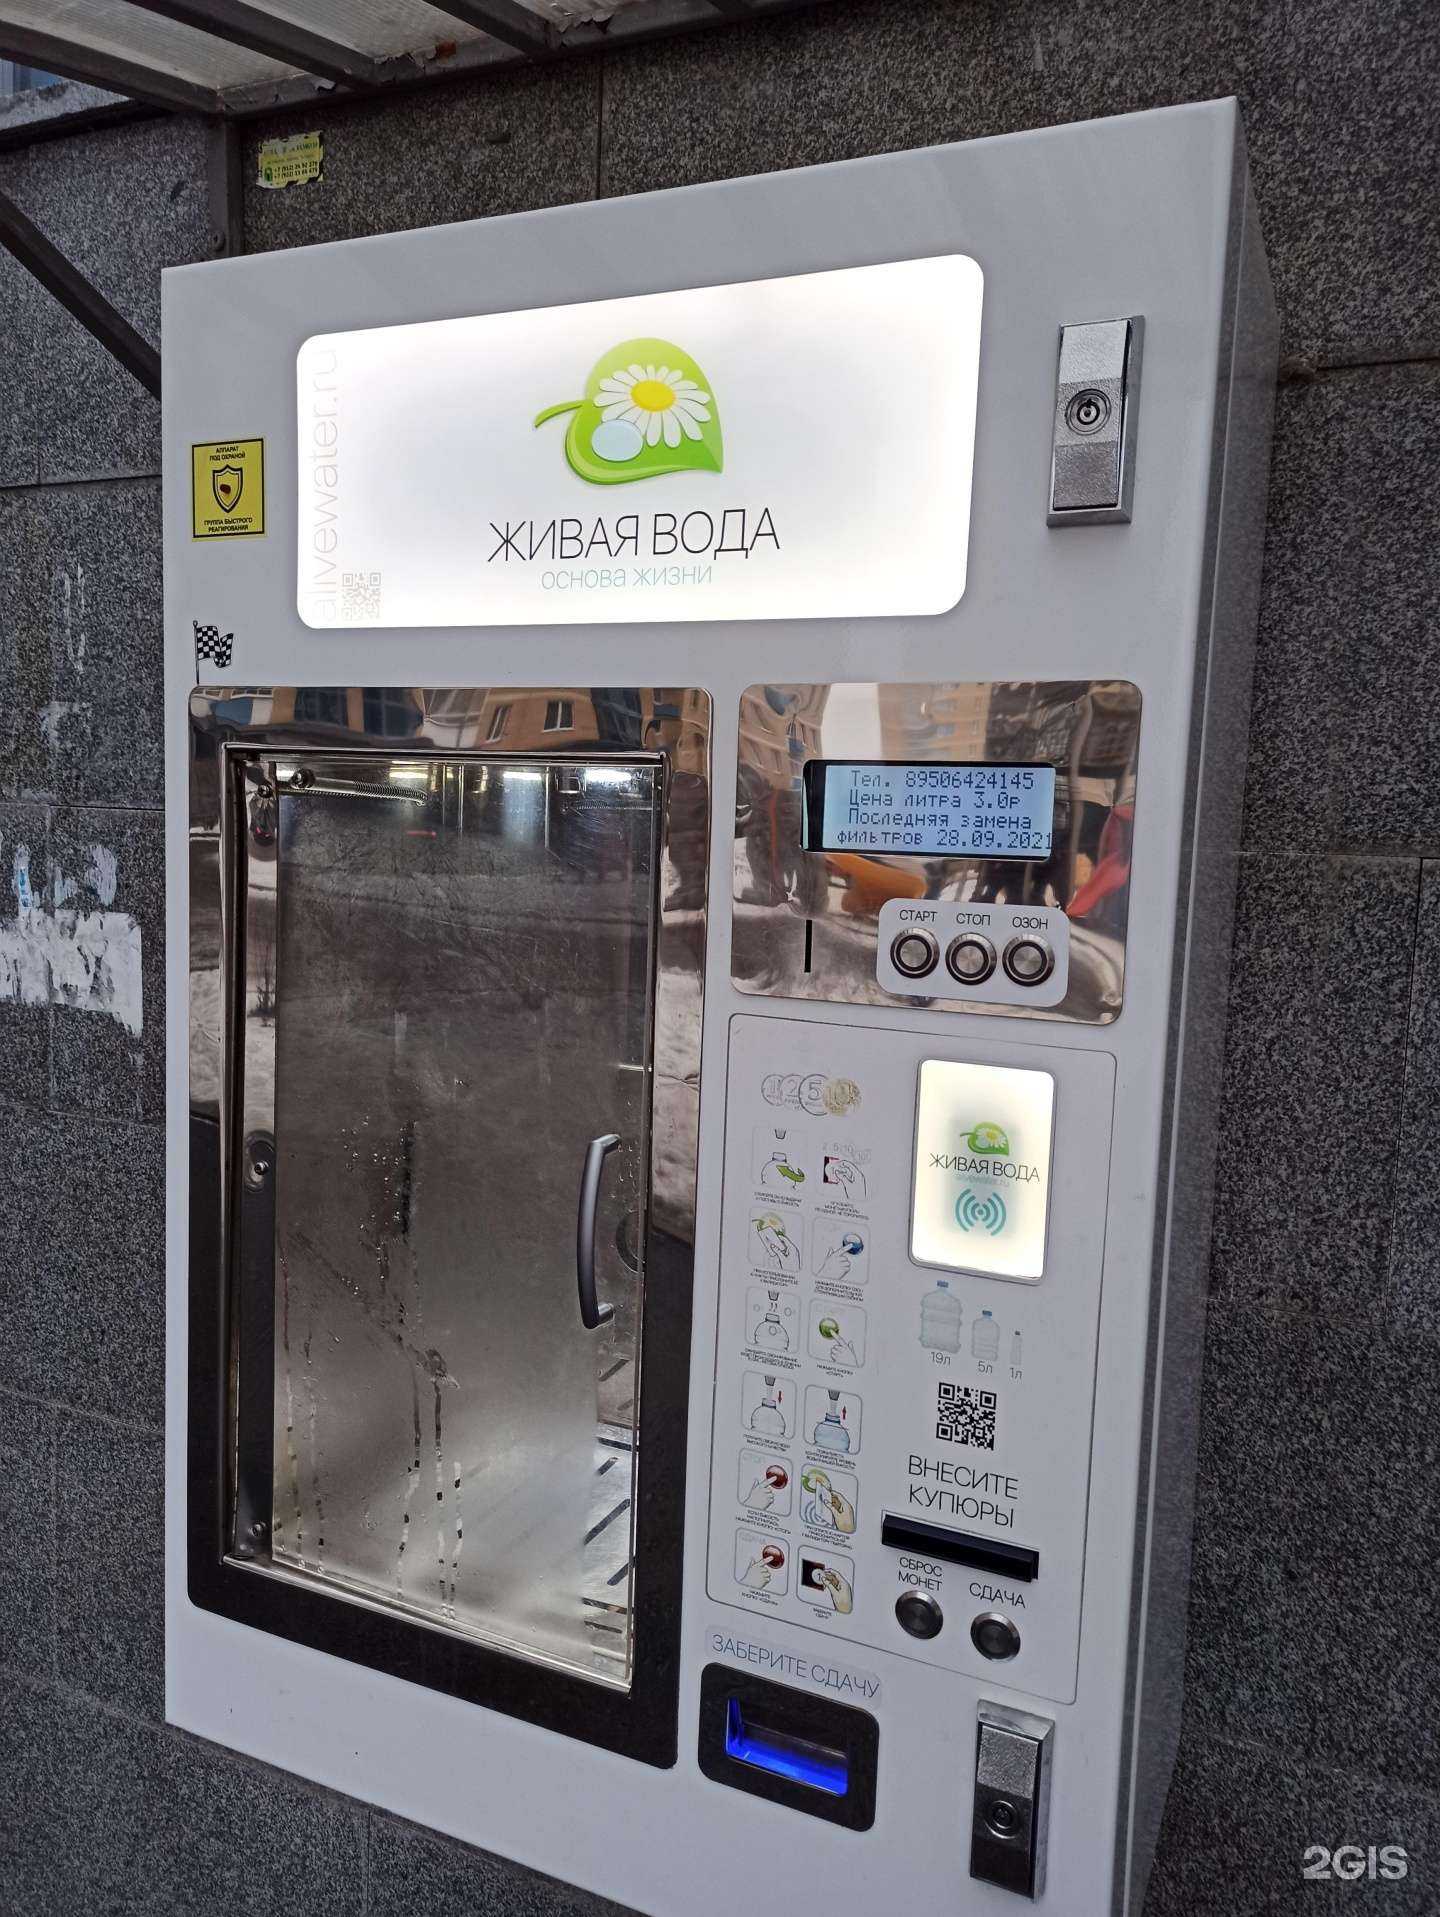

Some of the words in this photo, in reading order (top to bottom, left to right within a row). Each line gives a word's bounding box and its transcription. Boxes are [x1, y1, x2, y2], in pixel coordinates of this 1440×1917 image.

[215, 446, 239, 454] АППАРАТ
[221, 451, 246, 460] ОХРАНОЙ
[304, 349, 339, 622] alivewater.ru
[203, 518, 223, 526] ГРУППА
[224, 517, 253, 525] БЫСТРОГО
[208, 525, 249, 533] РЕАГИРОВАНИЯ
[488, 515, 639, 562] ЖИВАЯ
[652, 507, 780, 560] ВОДА
[541, 568, 626, 590] основа
[633, 565, 713, 585] жизни
[851, 770, 891, 788] Тел.
[904, 771, 1035, 790] 89506424145
[850, 789, 893, 808] Цена
[904, 794, 961, 808] литра
[849, 808, 949, 828] Последняя
[961, 814, 1032, 829] замена
[837, 830, 923, 847] фильтров
[936, 829, 1053, 850] 28.09.2021
[899, 909, 938, 923] СТАРТ
[956, 913, 991, 926] СТОП
[1012, 916, 1049, 930] ОЗОН
[786, 1079, 799, 1097] 2
[807, 1080, 823, 1100] 5
[929, 1152, 989, 1175] ЖИВАЯ
[992, 1161, 1040, 1183] ВОДА
[930, 1352, 951, 1366] 19л
[977, 1361, 993, 1374] 5л
[1009, 1367, 1023, 1379] 1л
[908, 1454, 1019, 1499] ВНЕСИТЕ
[909, 1484, 1014, 1528] КУПЮРЫ
[899, 1556, 943, 1577] СБРОС
[898, 1571, 943, 1592] МОНЕТ
[969, 1582, 1027, 1609] СДАЧА
[712, 1634, 809, 1679] ЗАБЕРИТЕ
[811, 1664, 880, 1698] СДАЧУ
